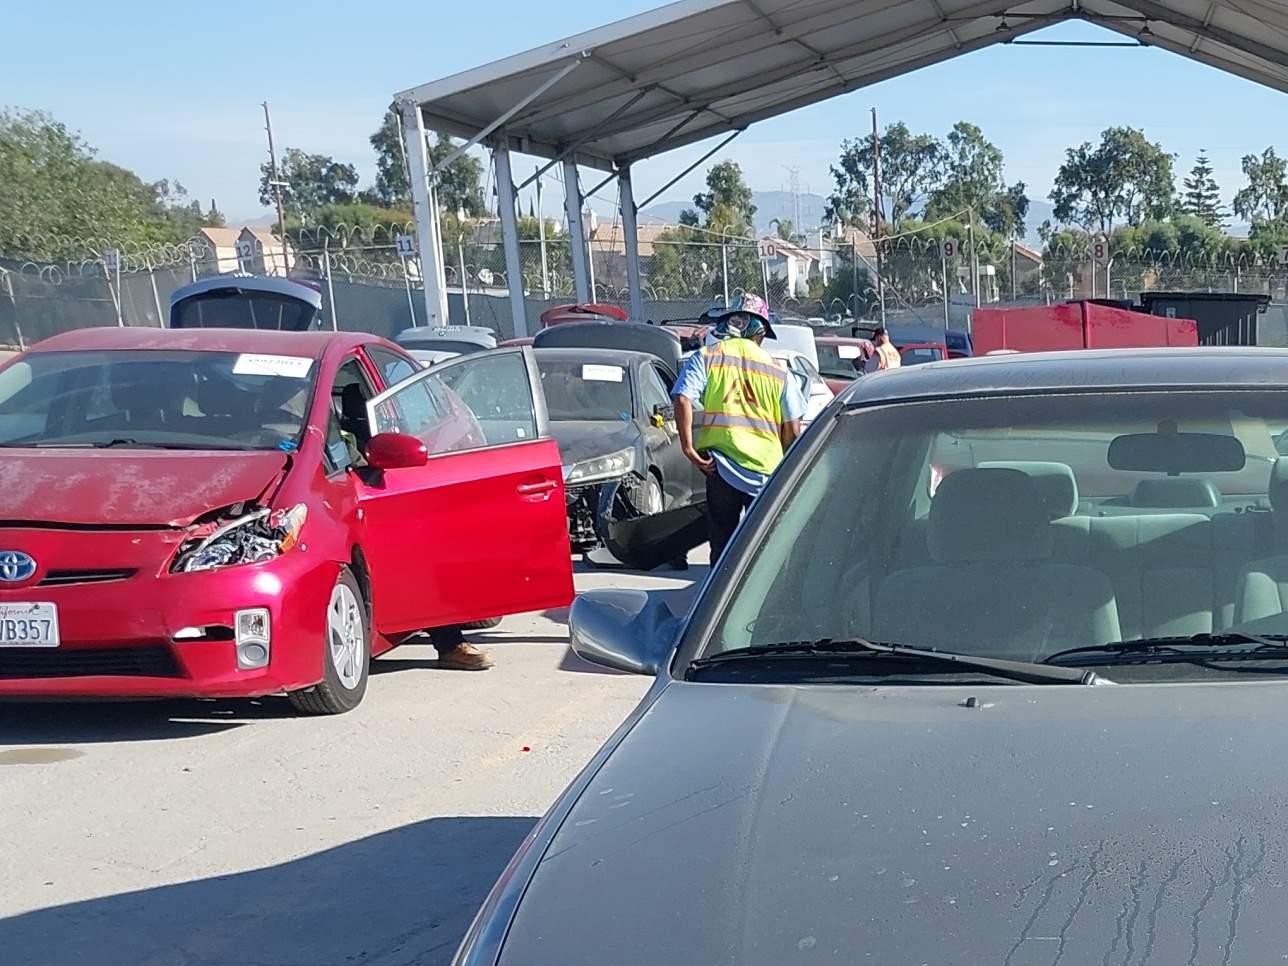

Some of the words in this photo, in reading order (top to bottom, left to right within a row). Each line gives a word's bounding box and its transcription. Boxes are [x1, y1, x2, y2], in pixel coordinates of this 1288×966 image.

[397, 239, 414, 252] 11
[761, 244, 775, 257] 10
[944, 242, 953, 257] 9
[1094, 244, 1104, 258] 8
